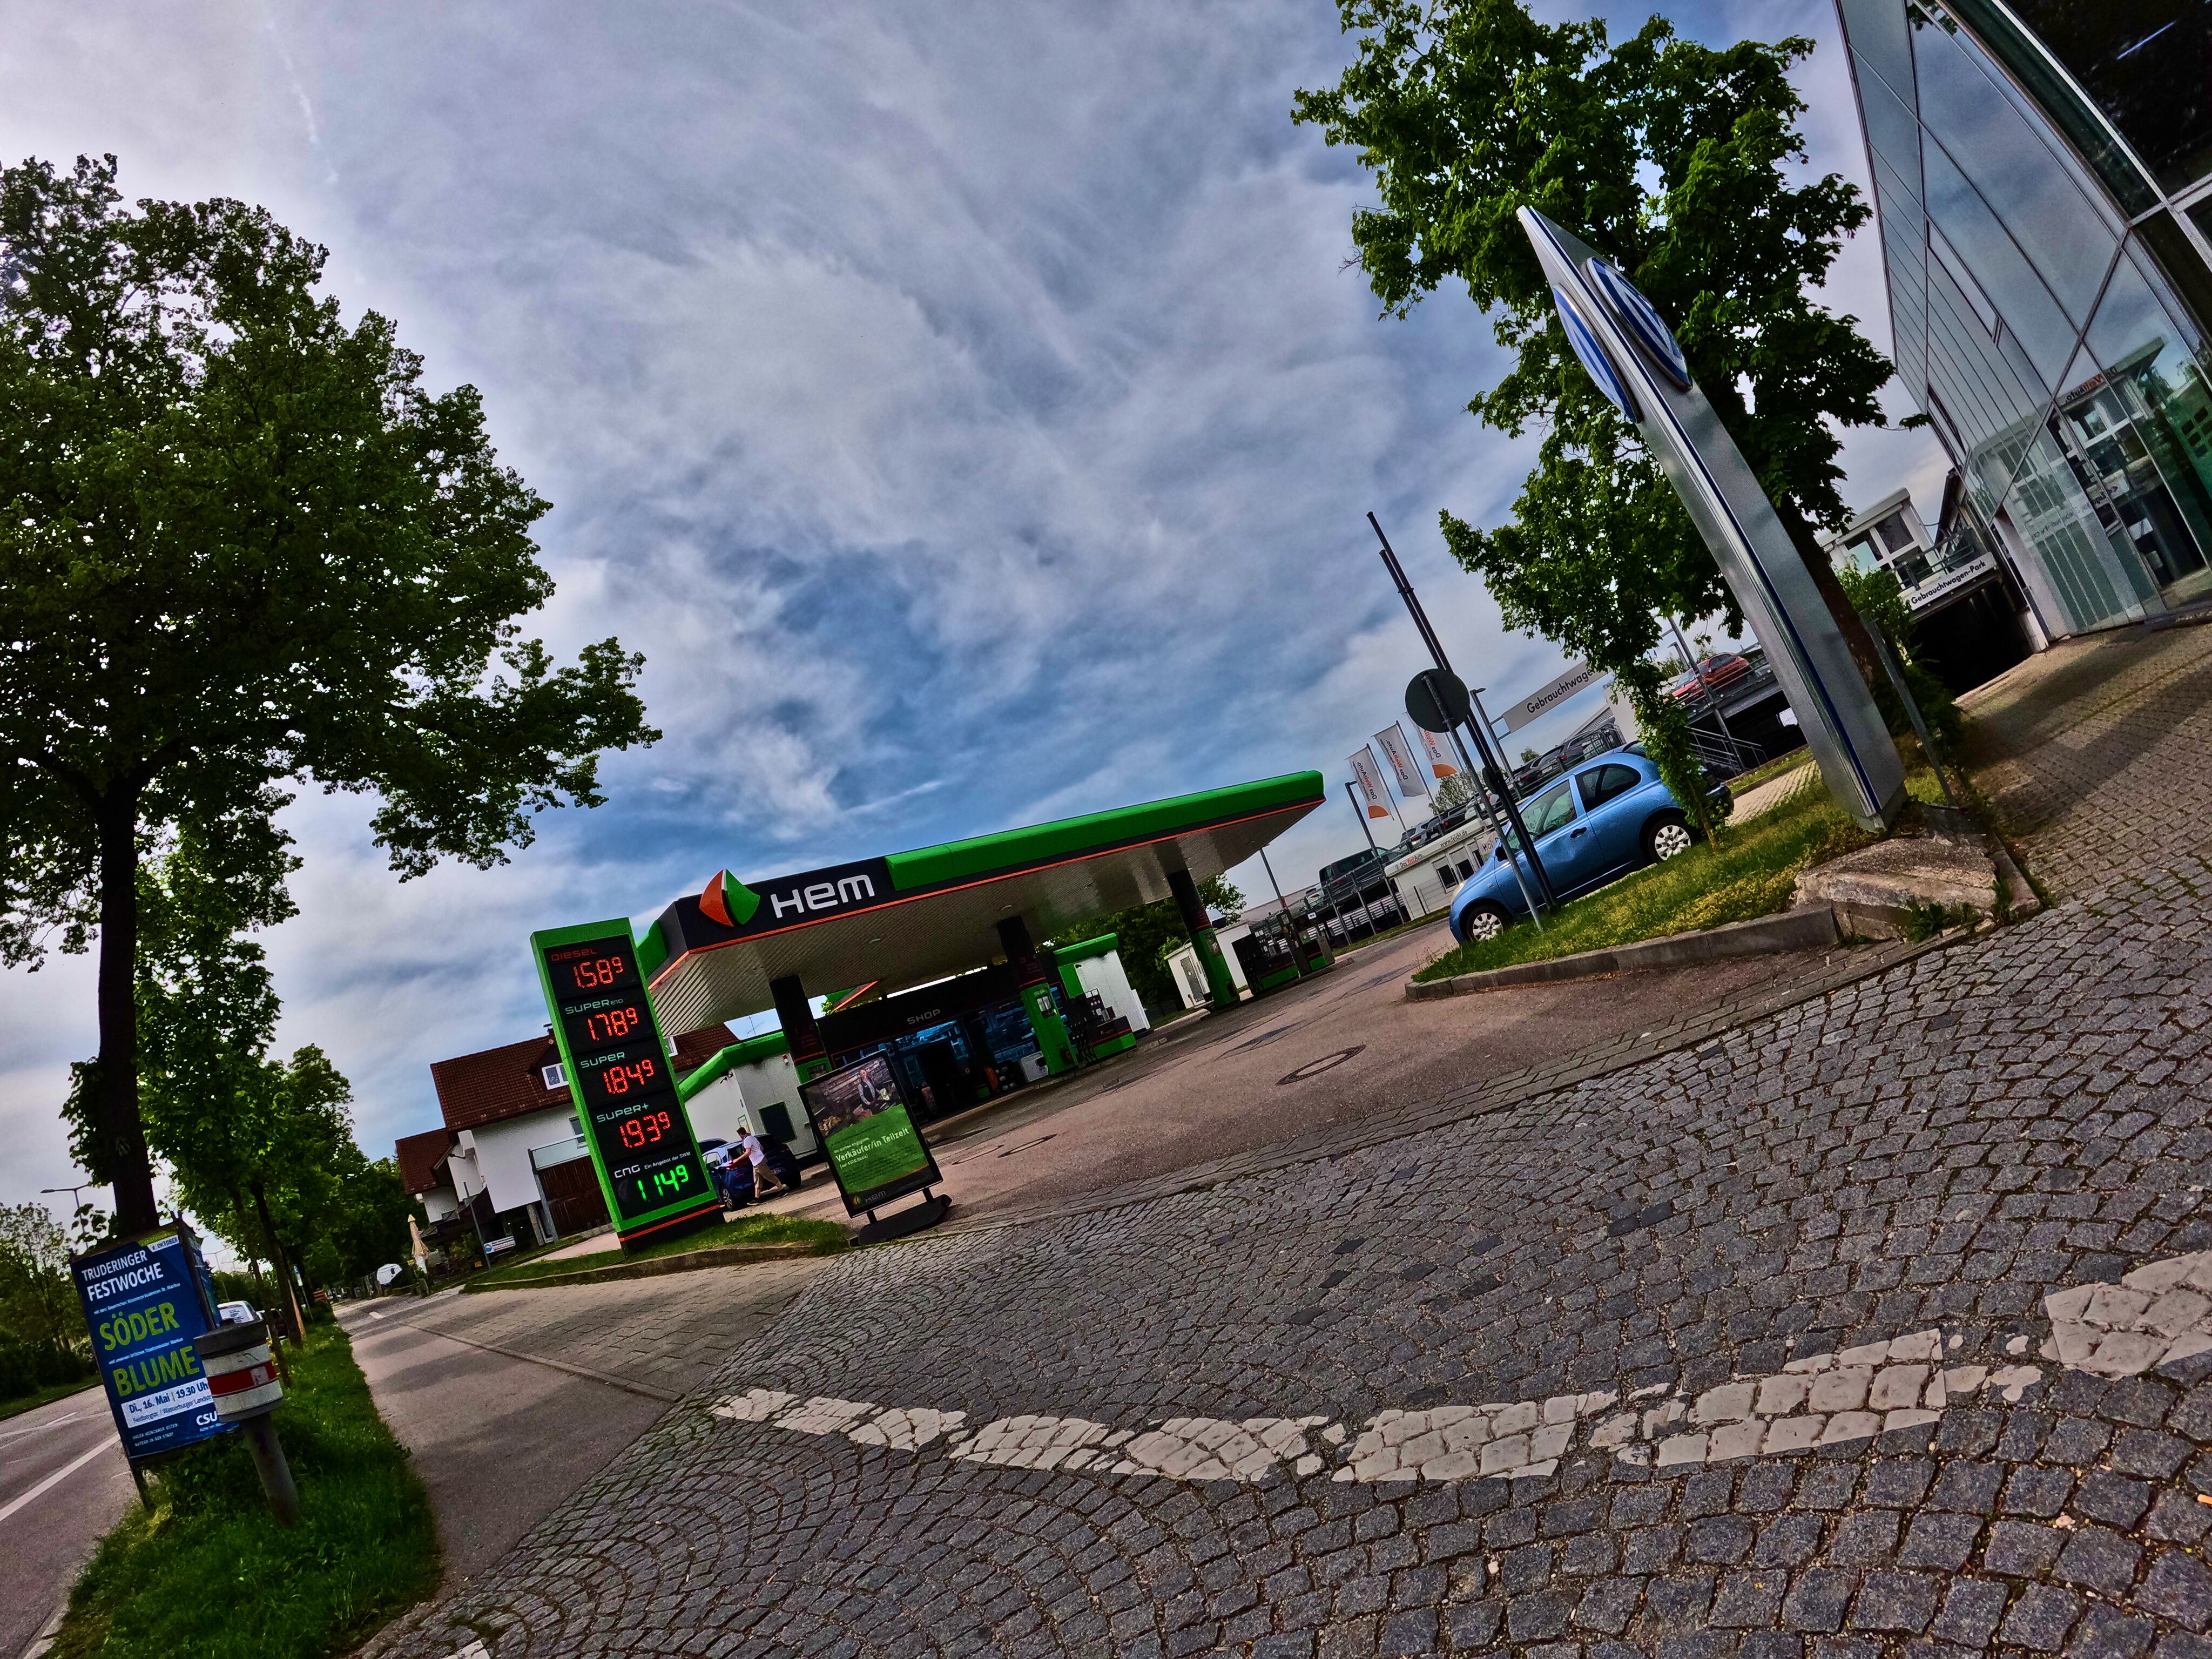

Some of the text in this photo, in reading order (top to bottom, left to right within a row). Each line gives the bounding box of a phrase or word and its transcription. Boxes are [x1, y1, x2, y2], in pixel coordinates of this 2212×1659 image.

[1911, 560, 1986, 604] Gebrauchtwagen-Park
[1527, 669, 1594, 713] Gebrauchtwage
[907, 1009, 941, 1024] SHOP
[652, 1157, 671, 1167] Angebot
[835, 1140, 882, 1162] Verkäufer/in
[881, 1128, 909, 1144] Teilzeit
[82, 1250, 148, 1282] TRUDERINGER
[86, 1262, 164, 1301] FESTWOCHE
[99, 1302, 180, 1351] SÖDER
[113, 1345, 200, 1397] BLUME
[143, 1399, 155, 1410] 16.
[155, 1393, 171, 1405] Mai
[176, 1386, 196, 1399] 19.30
[196, 1411, 218, 1426] CSU
